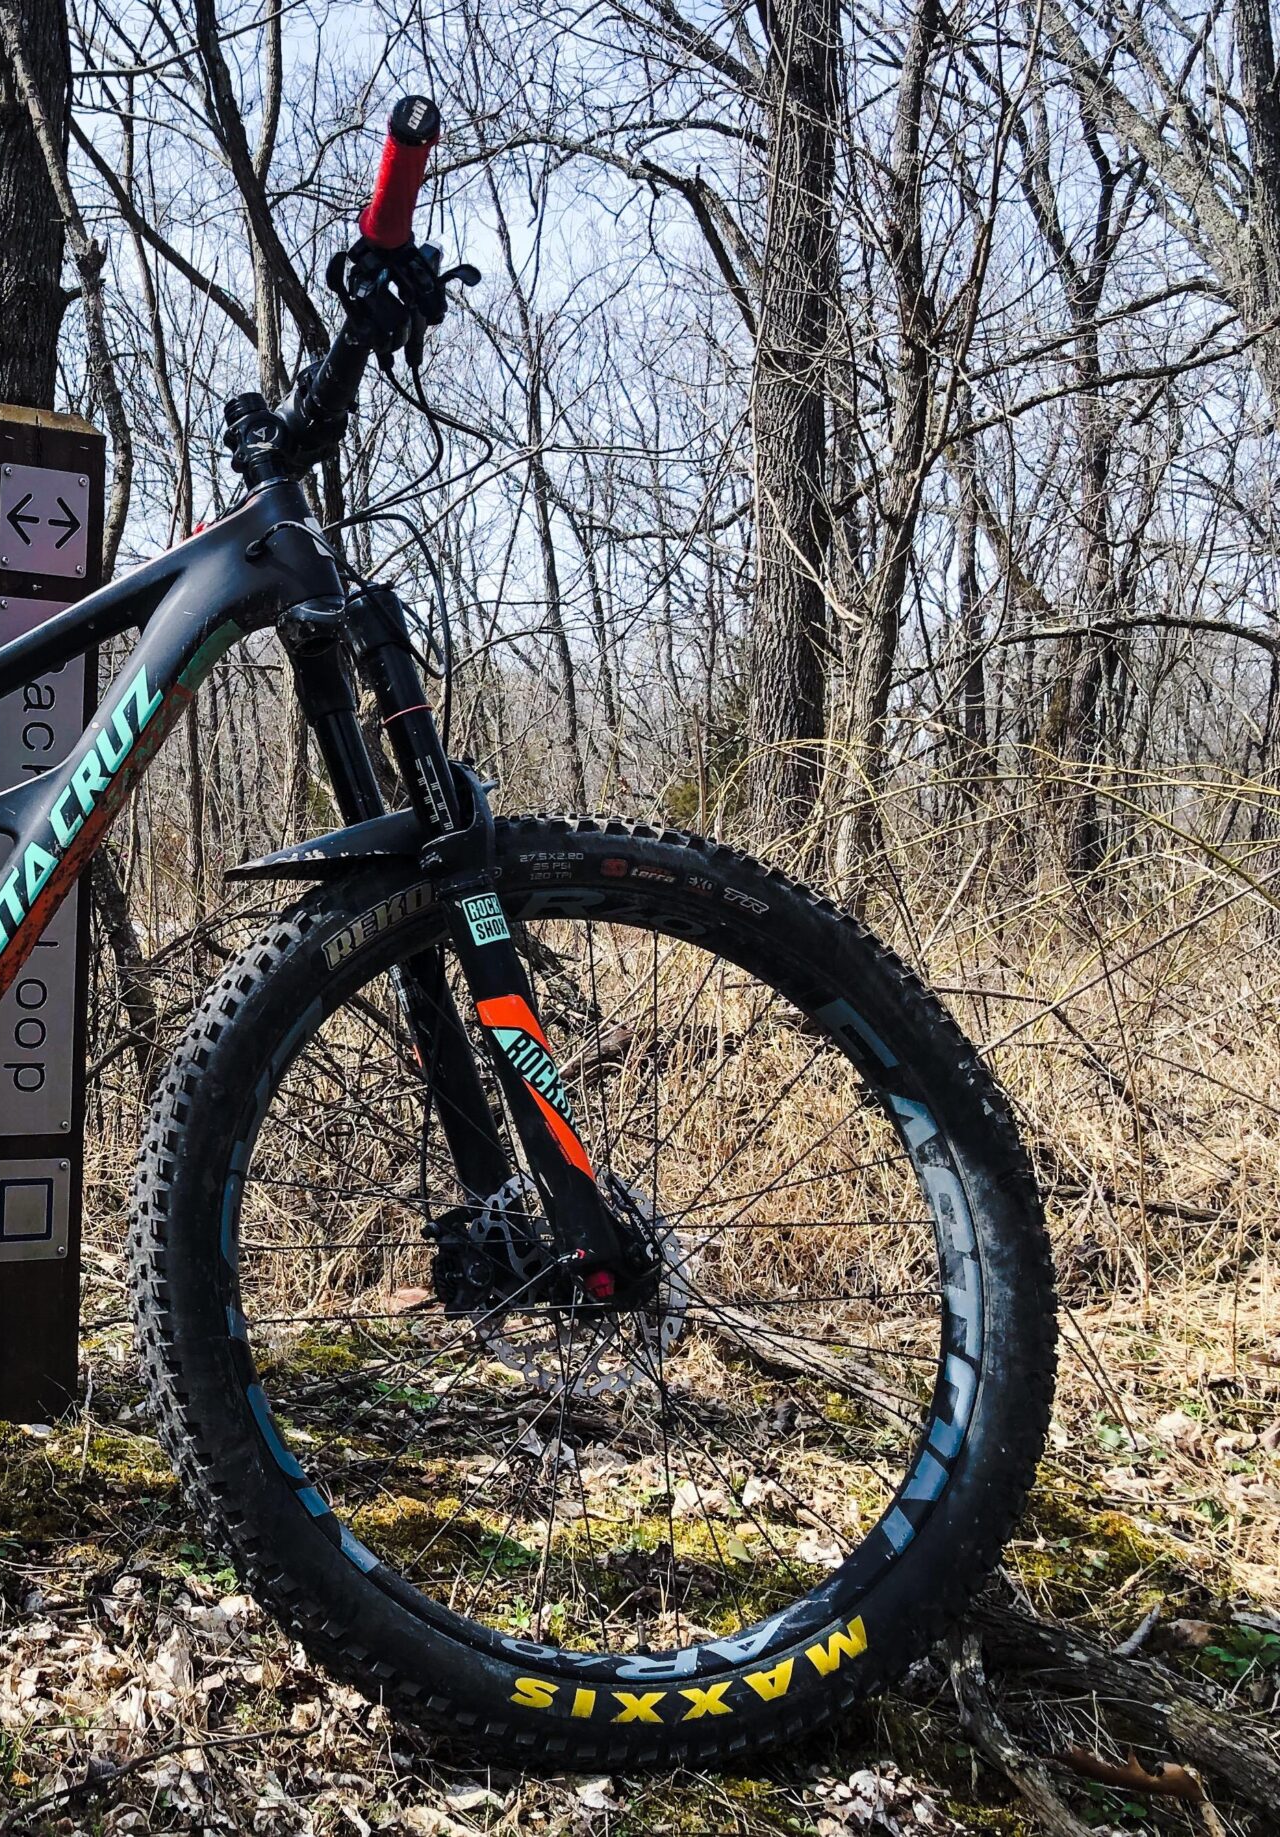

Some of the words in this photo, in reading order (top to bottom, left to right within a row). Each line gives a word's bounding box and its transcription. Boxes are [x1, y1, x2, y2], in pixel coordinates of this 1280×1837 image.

[48, 664, 163, 850] CRUZ
[321, 878, 437, 971] REKO
[467, 897, 501, 921] ROCK
[475, 918, 508, 941] SHOX
[724, 886, 770, 915] TR
[510, 1614, 869, 1724] MAXXIS
